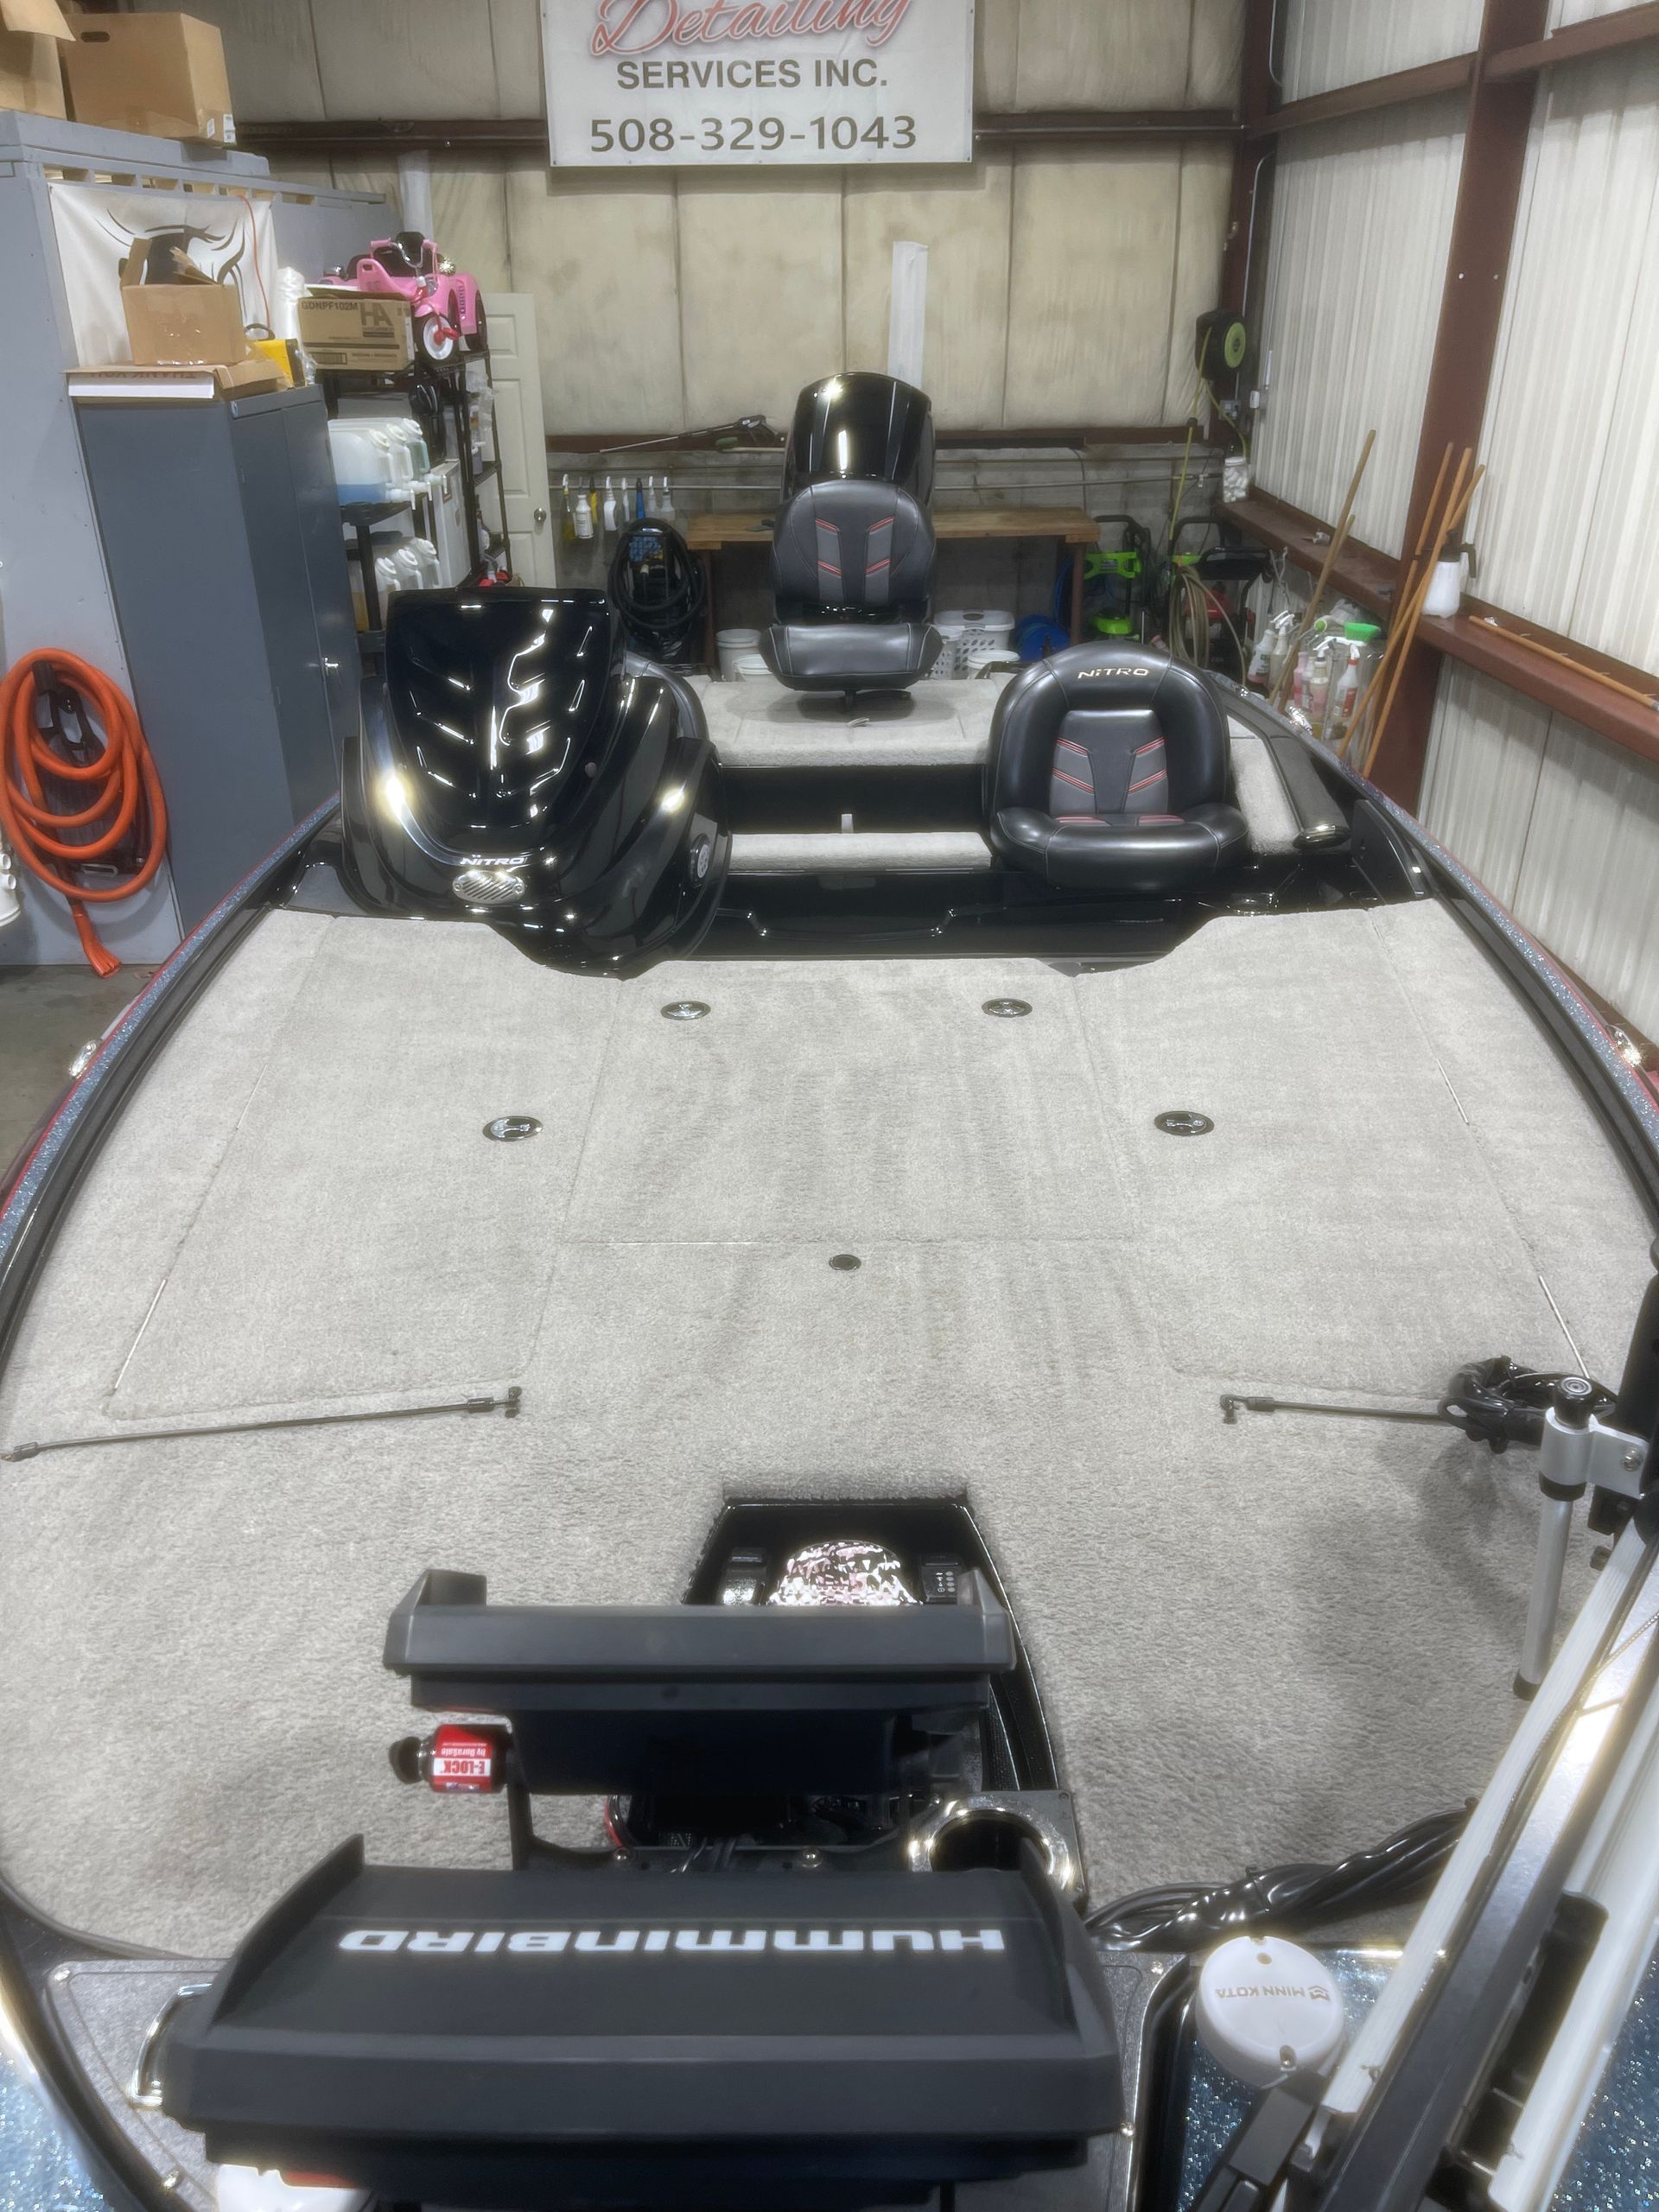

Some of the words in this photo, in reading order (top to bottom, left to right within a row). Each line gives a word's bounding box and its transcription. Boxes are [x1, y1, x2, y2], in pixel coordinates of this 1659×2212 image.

[617, 59, 801, 89] SERVICES
[815, 58, 887, 87] INC.
[590, 116, 917, 152] 508-329-1043
[460, 857, 525, 866] NITRO
[442, 1759, 486, 1774] E-LOCK
[340, 1929, 1006, 1953] HUMMINBIRD
[1215, 1986, 1260, 1999] KOTA
[1262, 1986, 1306, 1998] MINN
